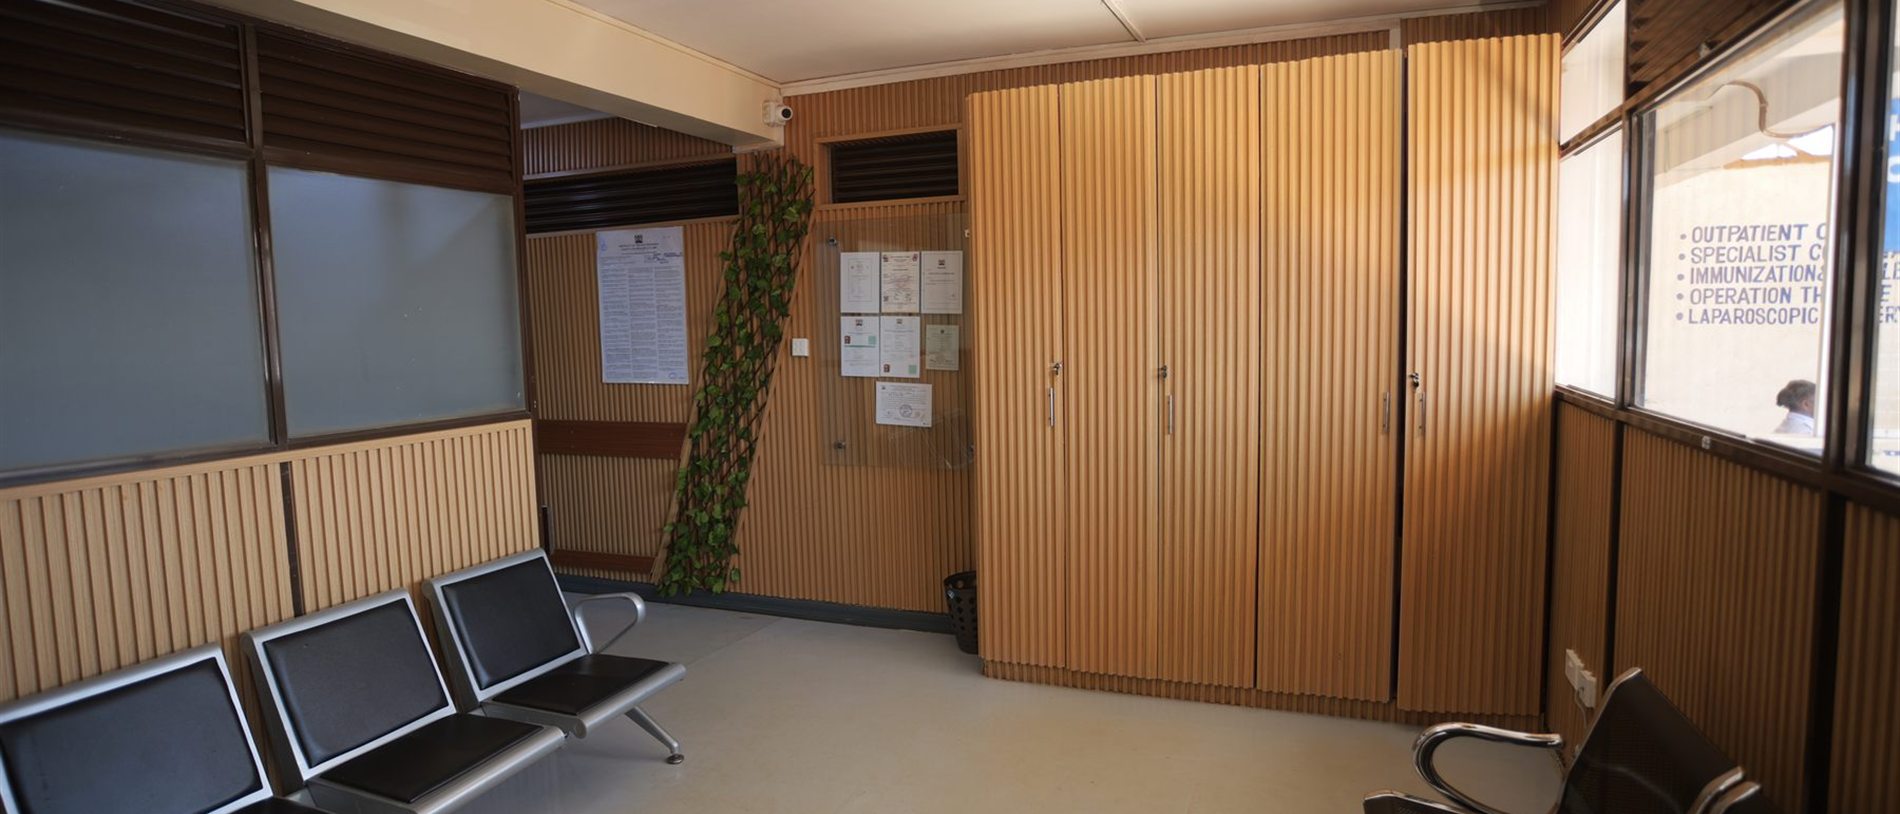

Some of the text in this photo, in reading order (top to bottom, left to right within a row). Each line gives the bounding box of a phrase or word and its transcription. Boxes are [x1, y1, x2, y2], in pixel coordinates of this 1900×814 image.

[1691, 224, 1808, 243] OUTPATIENT
[1690, 244, 1801, 264] SPECIALIST
[1690, 286, 1791, 305] OPERATION
[1688, 307, 1818, 325] LAPAROSCOPIC
